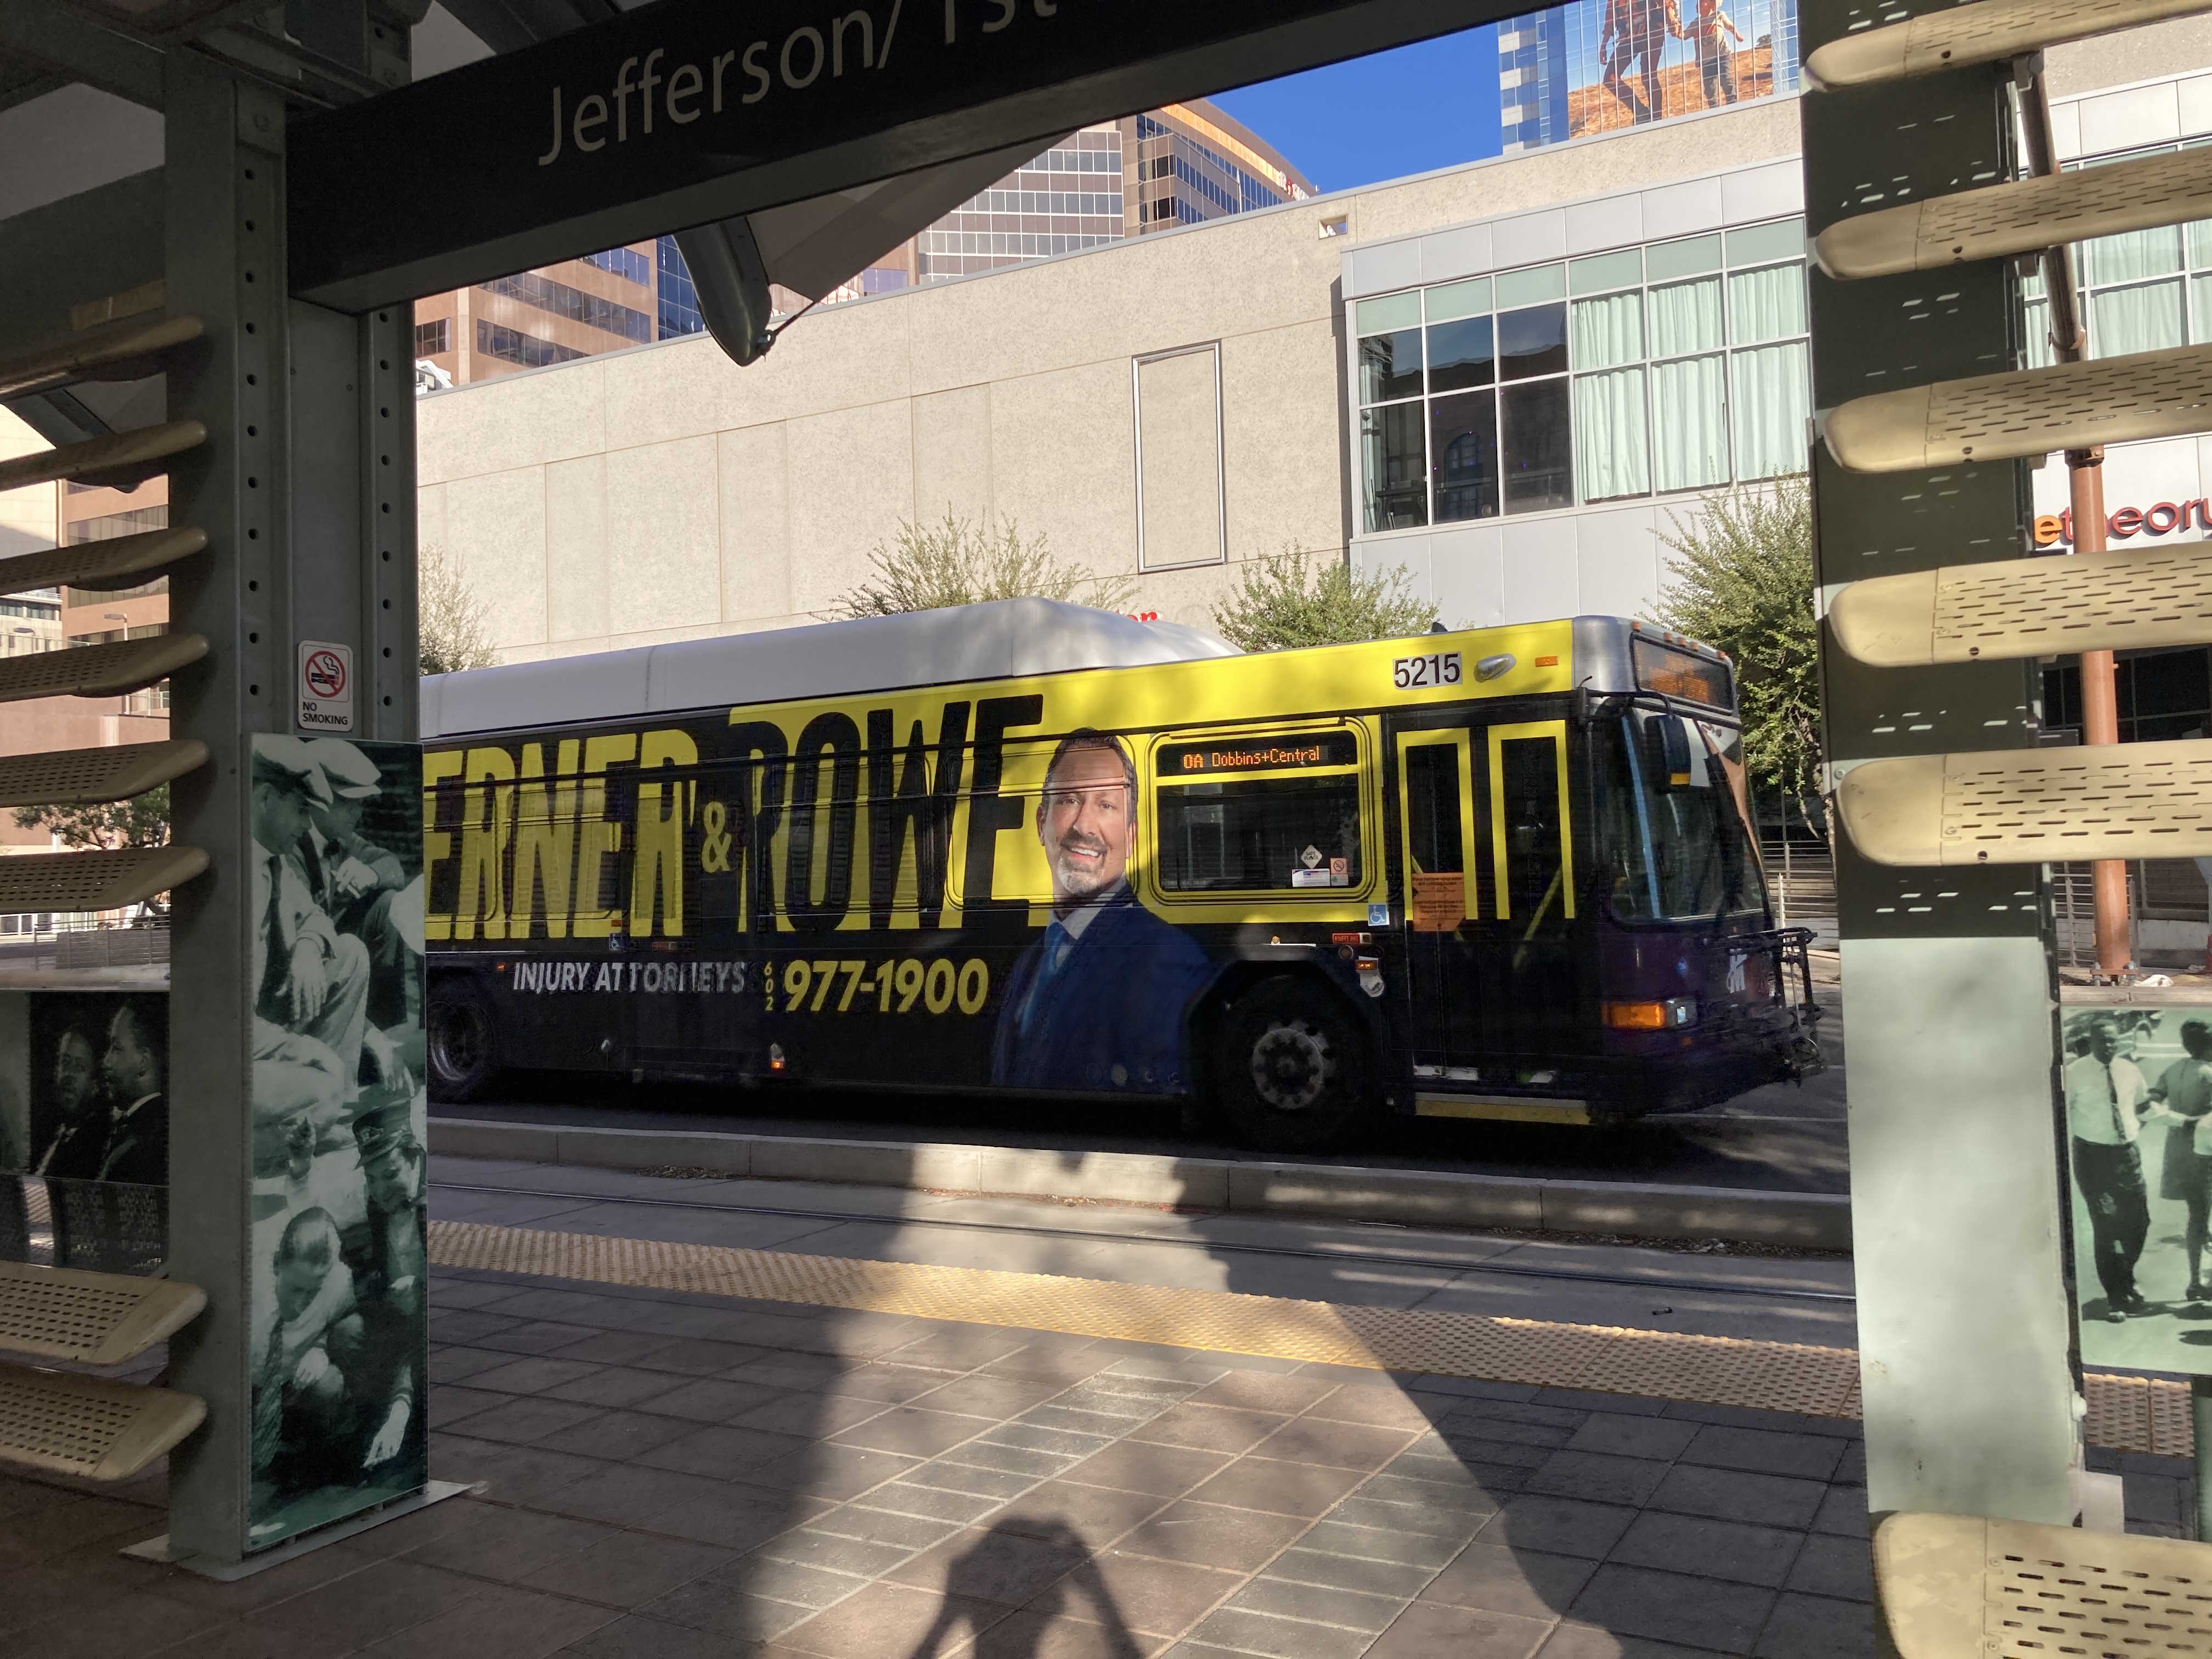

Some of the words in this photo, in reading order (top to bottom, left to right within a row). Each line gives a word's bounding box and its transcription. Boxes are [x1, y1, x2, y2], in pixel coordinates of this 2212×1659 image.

[944, 0, 1058, 46] 1s
[1394, 653, 1460, 688] 5215
[303, 702, 317, 711] NO
[303, 713, 348, 725] SMOKING
[1211, 745, 1320, 768] Dobbins+Central
[701, 801, 731, 872] &
[720, 694, 1043, 933] ROWE
[513, 961, 590, 994] INJURY
[783, 958, 989, 1015] 977-1900
